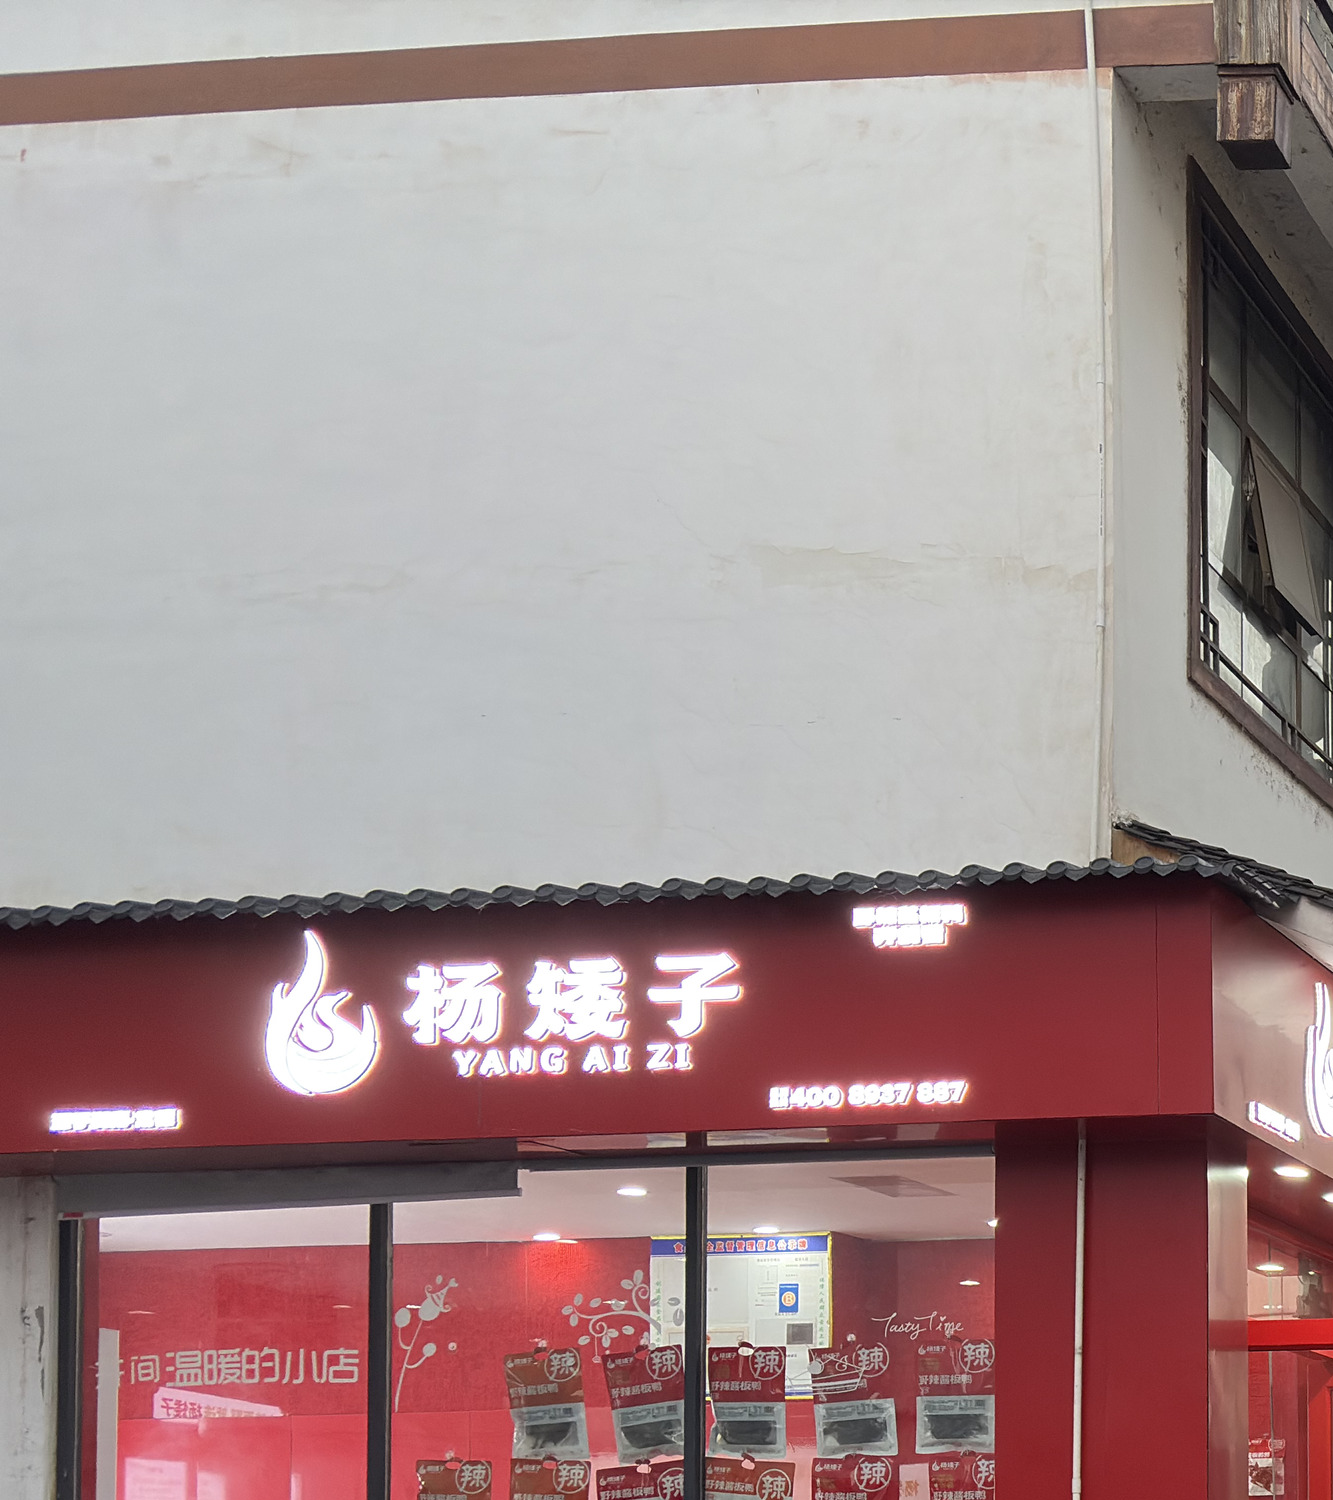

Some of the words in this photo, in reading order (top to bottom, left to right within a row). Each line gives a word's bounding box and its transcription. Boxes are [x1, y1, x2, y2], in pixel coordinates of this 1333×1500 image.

[403, 951, 744, 1046] 杨矮子
[453, 1046, 567, 1078] YANG
[581, 1044, 629, 1074] AI
[645, 1041, 694, 1071] ZI
[673, 1239, 808, 1254] 食全监督管理信息公示牌
[871, 1312, 928, 1340] Tasty
[921, 1311, 964, 1338] Time
